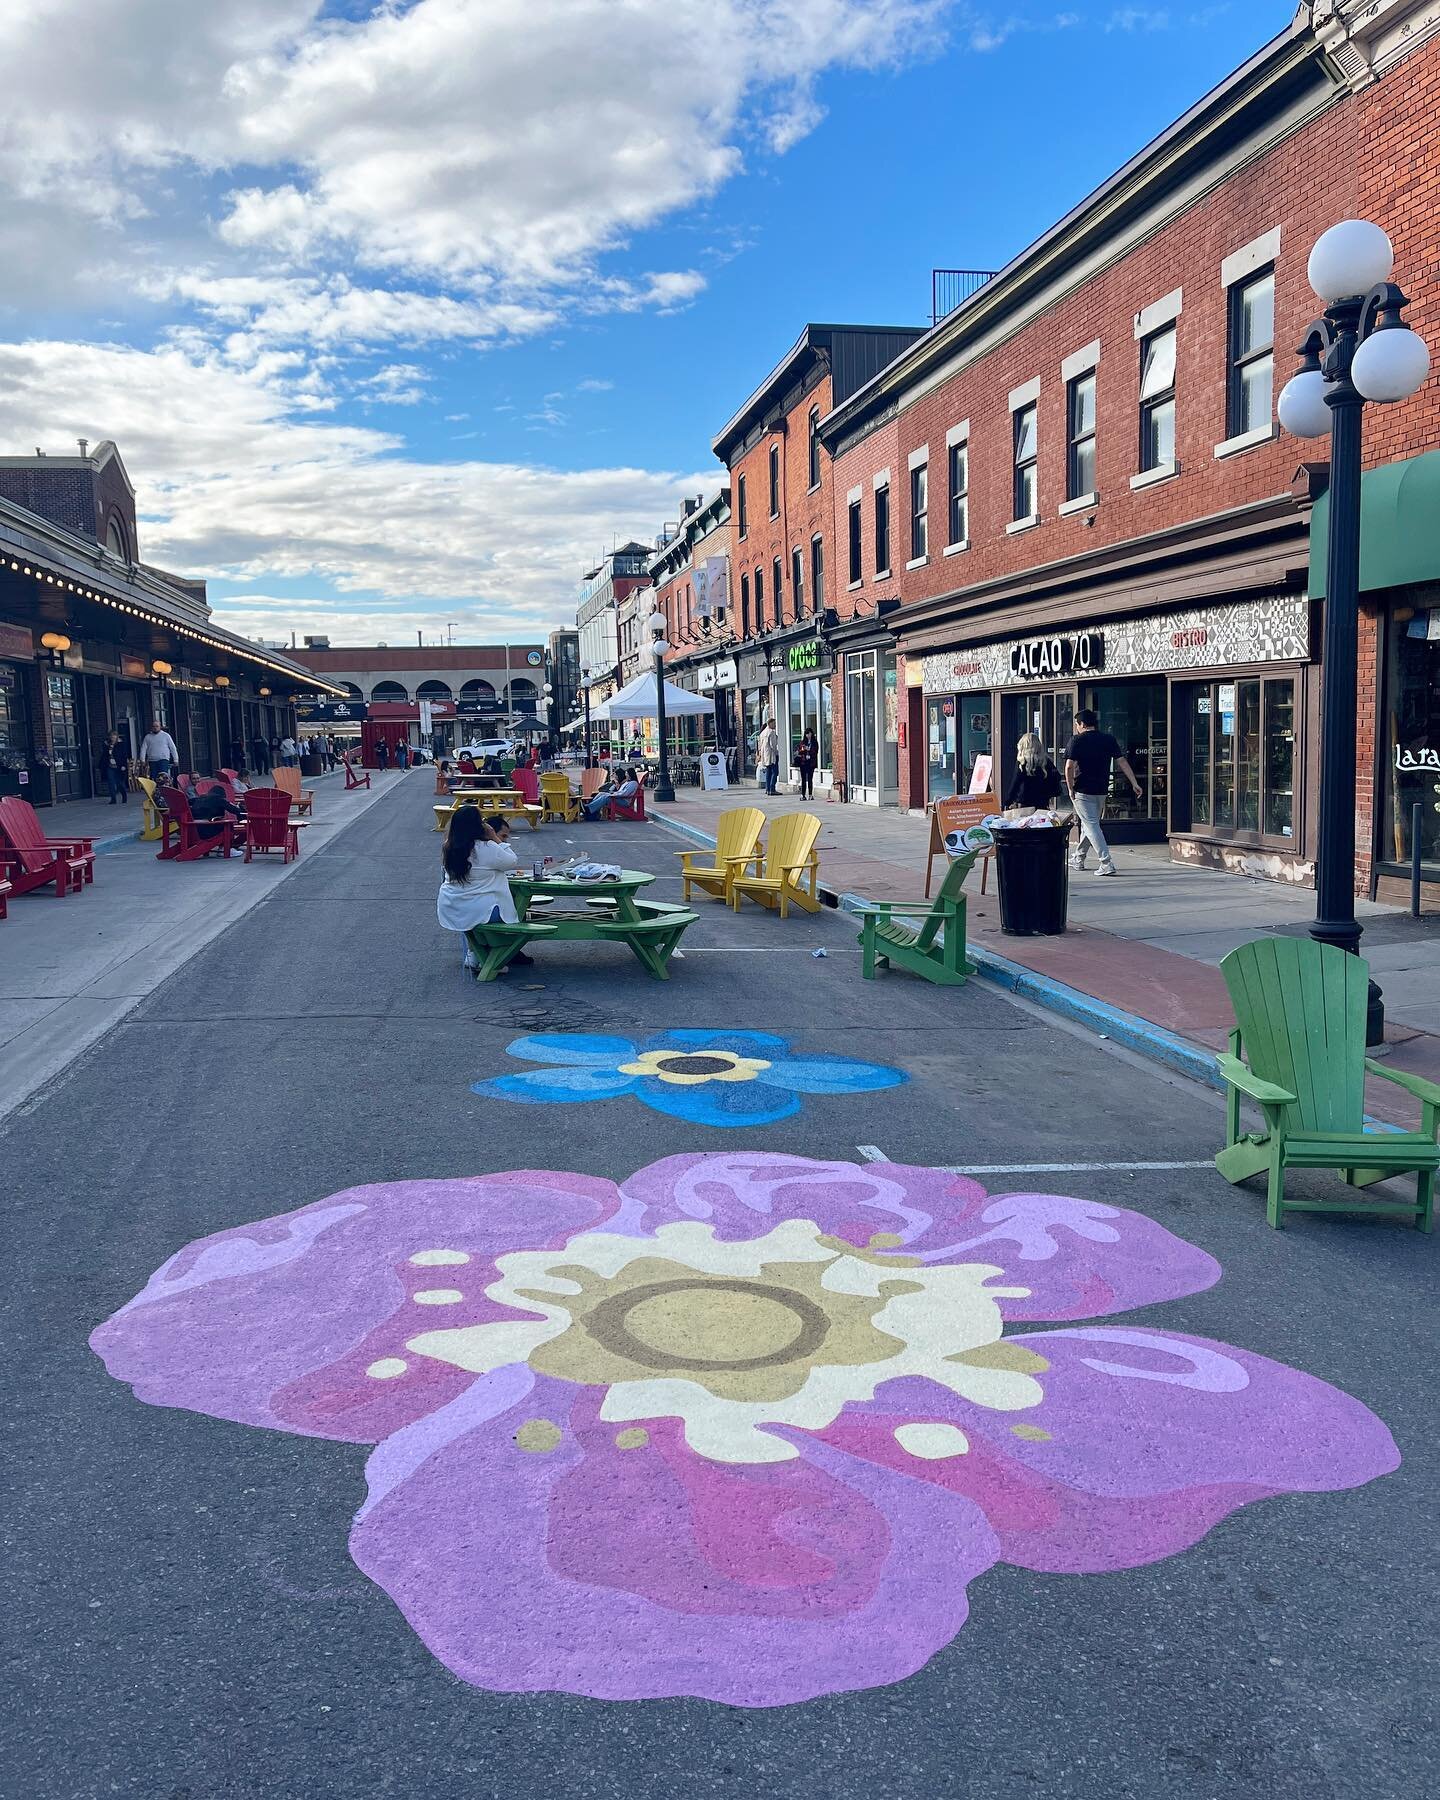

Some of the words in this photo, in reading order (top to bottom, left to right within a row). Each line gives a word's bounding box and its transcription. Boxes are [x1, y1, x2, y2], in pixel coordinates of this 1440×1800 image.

[1172, 628, 1207, 648] BISTRO
[789, 641, 818, 671] crocs
[1010, 639, 1062, 677] CACAO
[1070, 634, 1091, 669] 70
[1199, 703, 1211, 711] OPE
